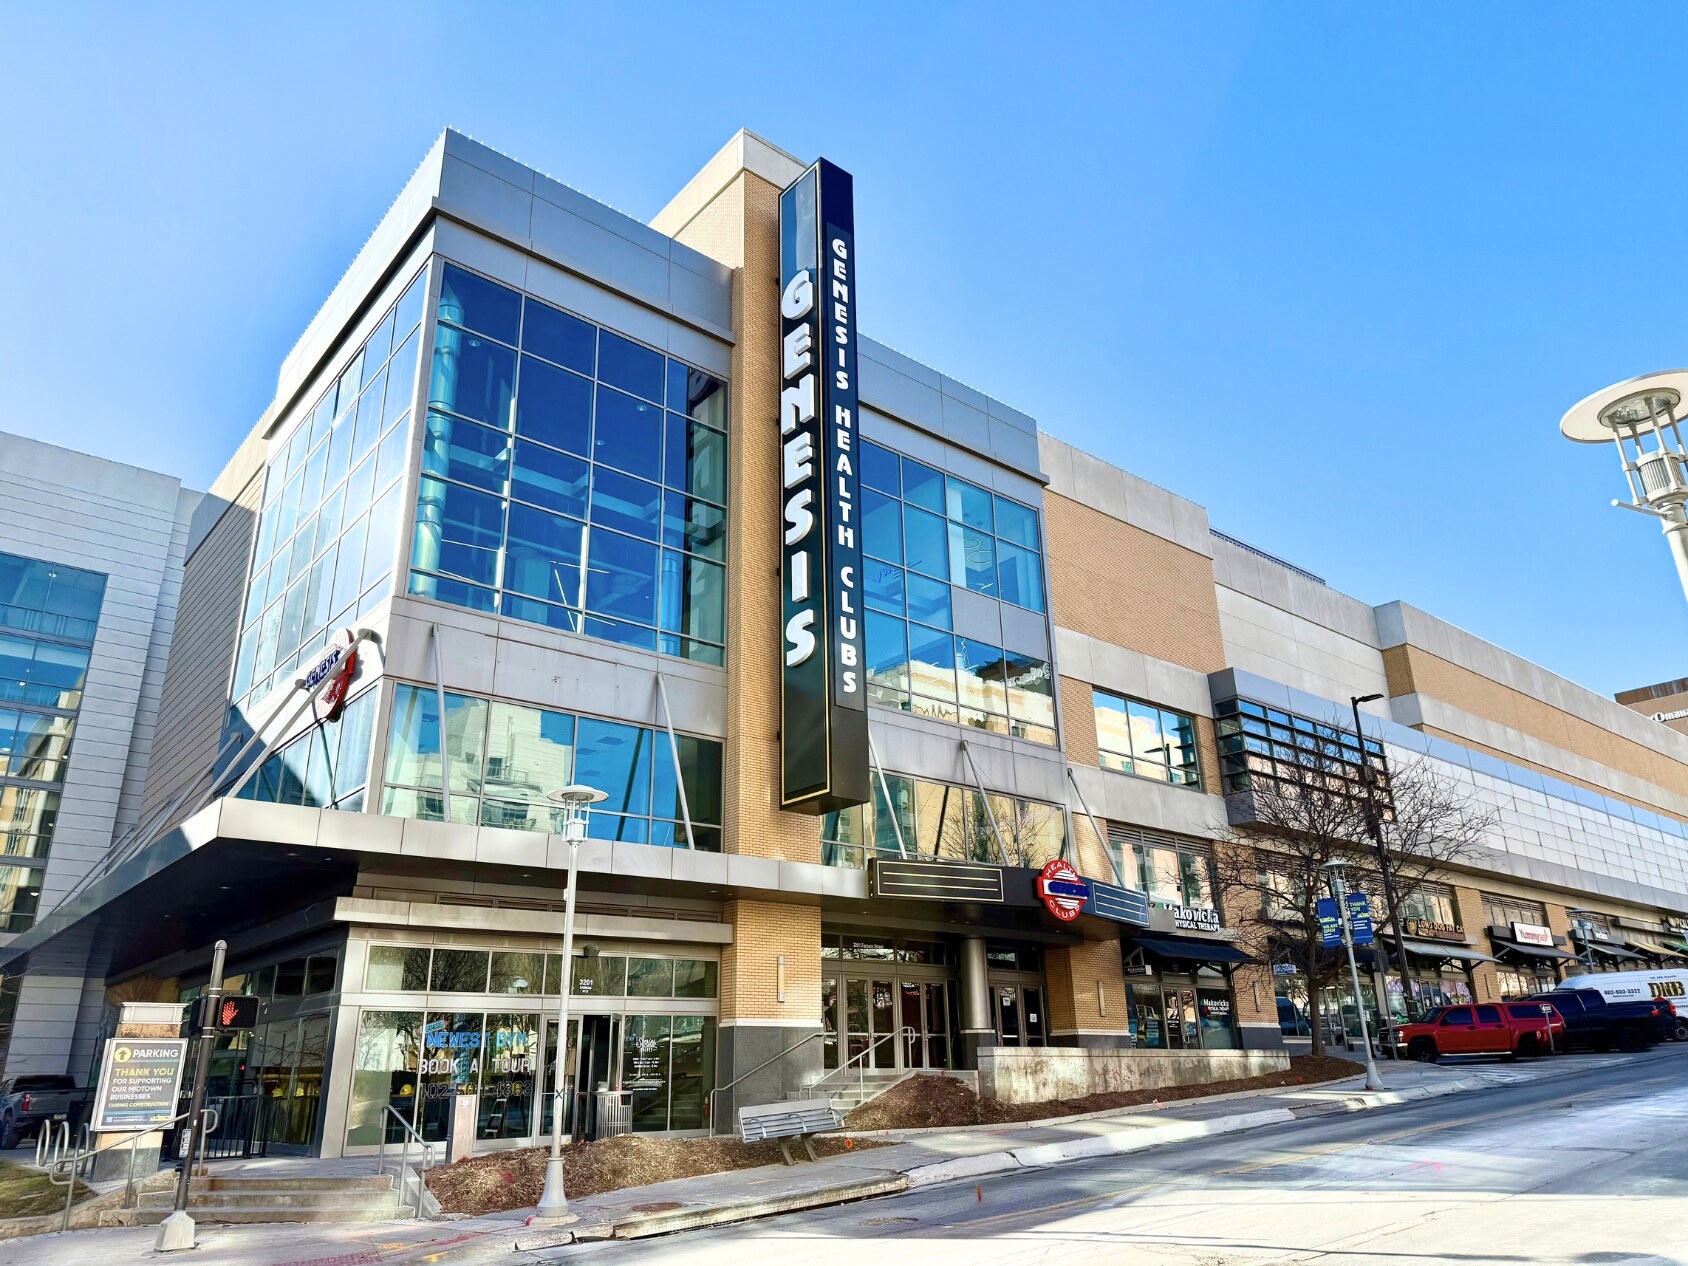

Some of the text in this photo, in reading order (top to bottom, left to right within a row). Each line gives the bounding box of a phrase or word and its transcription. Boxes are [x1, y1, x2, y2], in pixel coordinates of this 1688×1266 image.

[781, 269, 816, 667] GENESIS
[832, 238, 857, 693] GENESIS HEALTH CLUBS
[1046, 862, 1076, 878] HEALTH
[1050, 900, 1079, 918] CLUBS
[1198, 922, 1220, 932] THERAPY
[1418, 919, 1433, 929] LONG
[1434, 922, 1446, 931] DOG
[425, 1031, 527, 1049] NEWEST GYM
[132, 1049, 179, 1058] PARKING
[115, 1067, 174, 1076] THANK YOU
[419, 1058, 531, 1075] BOOK A TOUR
